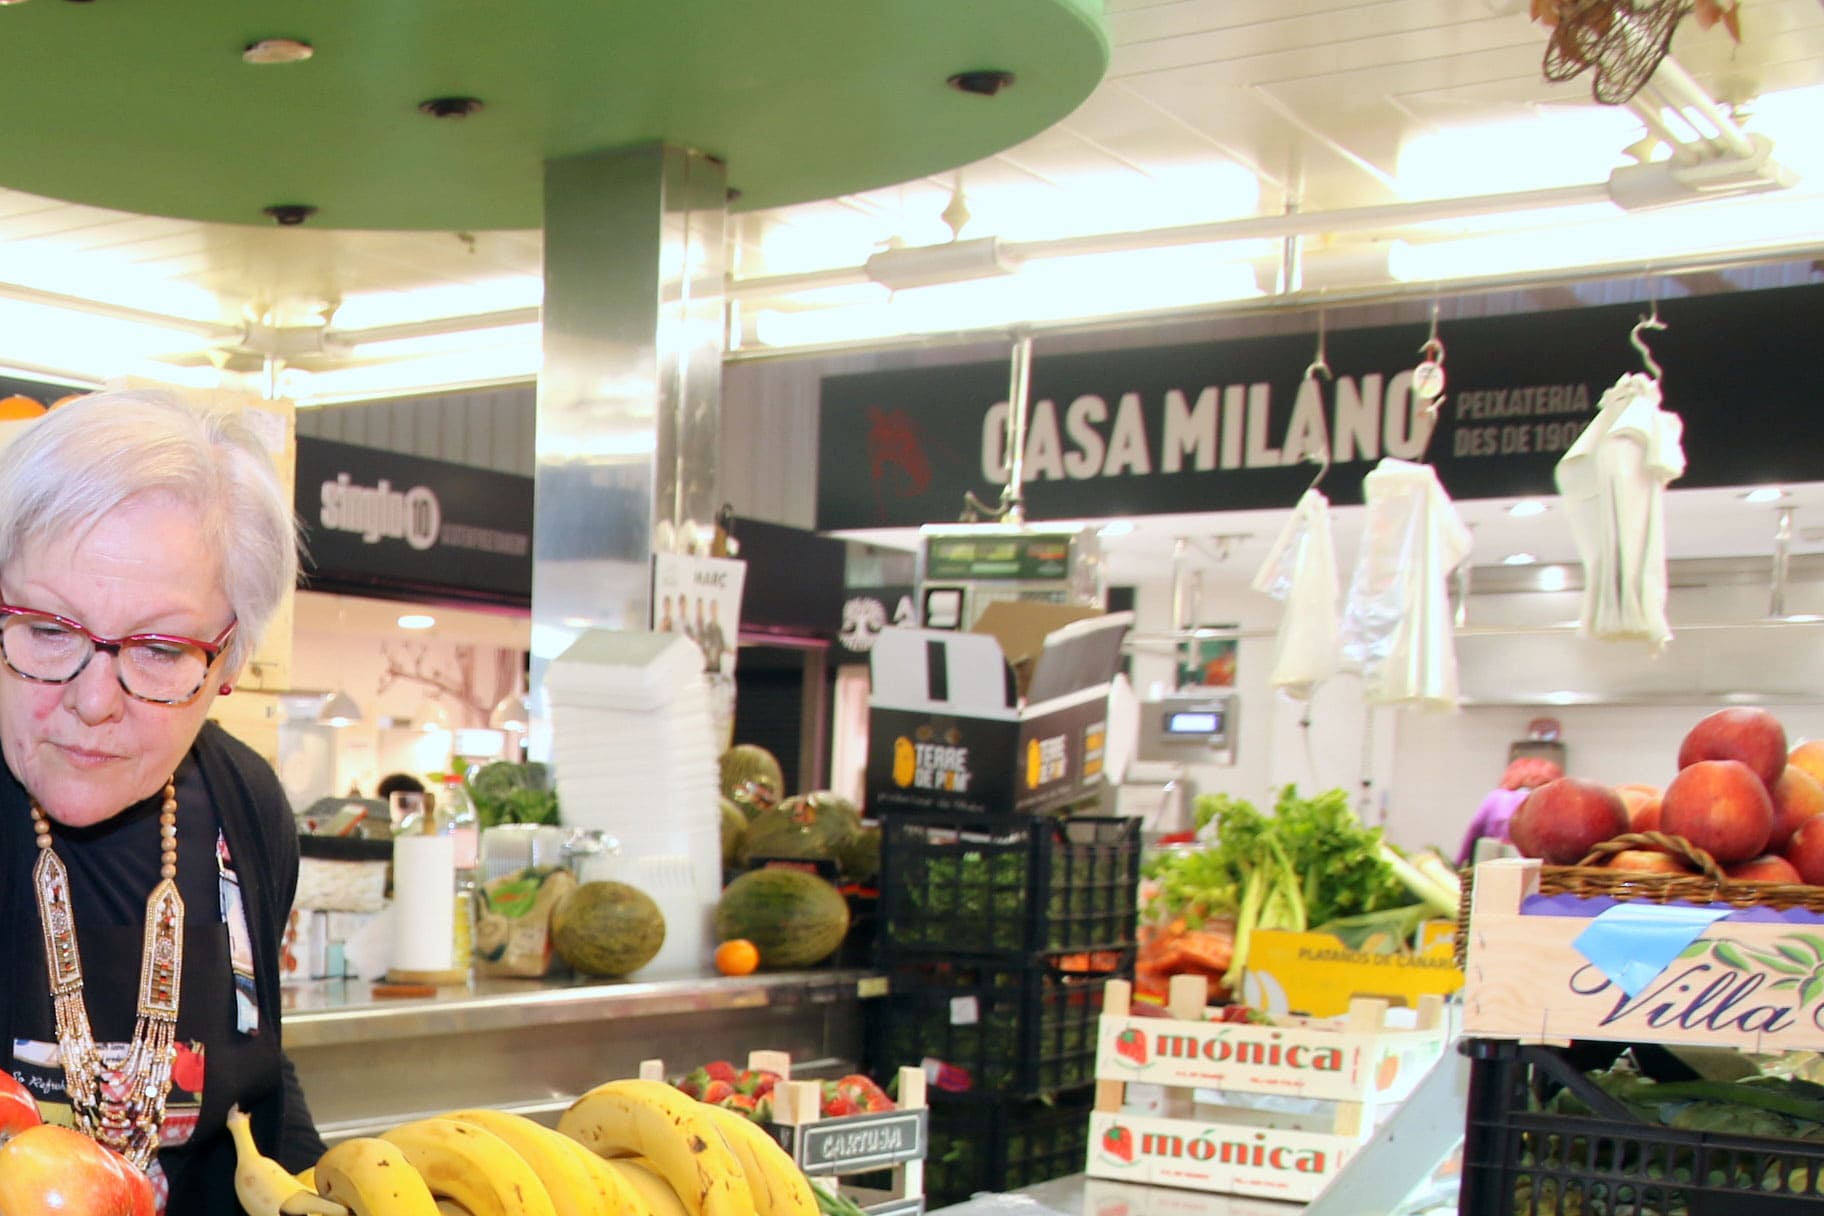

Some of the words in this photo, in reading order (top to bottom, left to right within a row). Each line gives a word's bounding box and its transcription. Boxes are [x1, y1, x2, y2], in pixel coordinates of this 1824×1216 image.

[1456, 382, 1589, 420] PEIXATERIA
[982, 390, 1151, 485] CASA
[1161, 368, 1428, 474] MILANO
[1454, 425, 1499, 457] DES
[1502, 423, 1531, 455] DE
[1535, 421, 1589, 453] 190
[915, 743, 968, 769] TERRE
[914, 768, 933, 790] DE
[1569, 962, 1798, 1034] Villa
[1156, 1029, 1344, 1072] mónica
[1141, 1129, 1327, 1175] mónica
